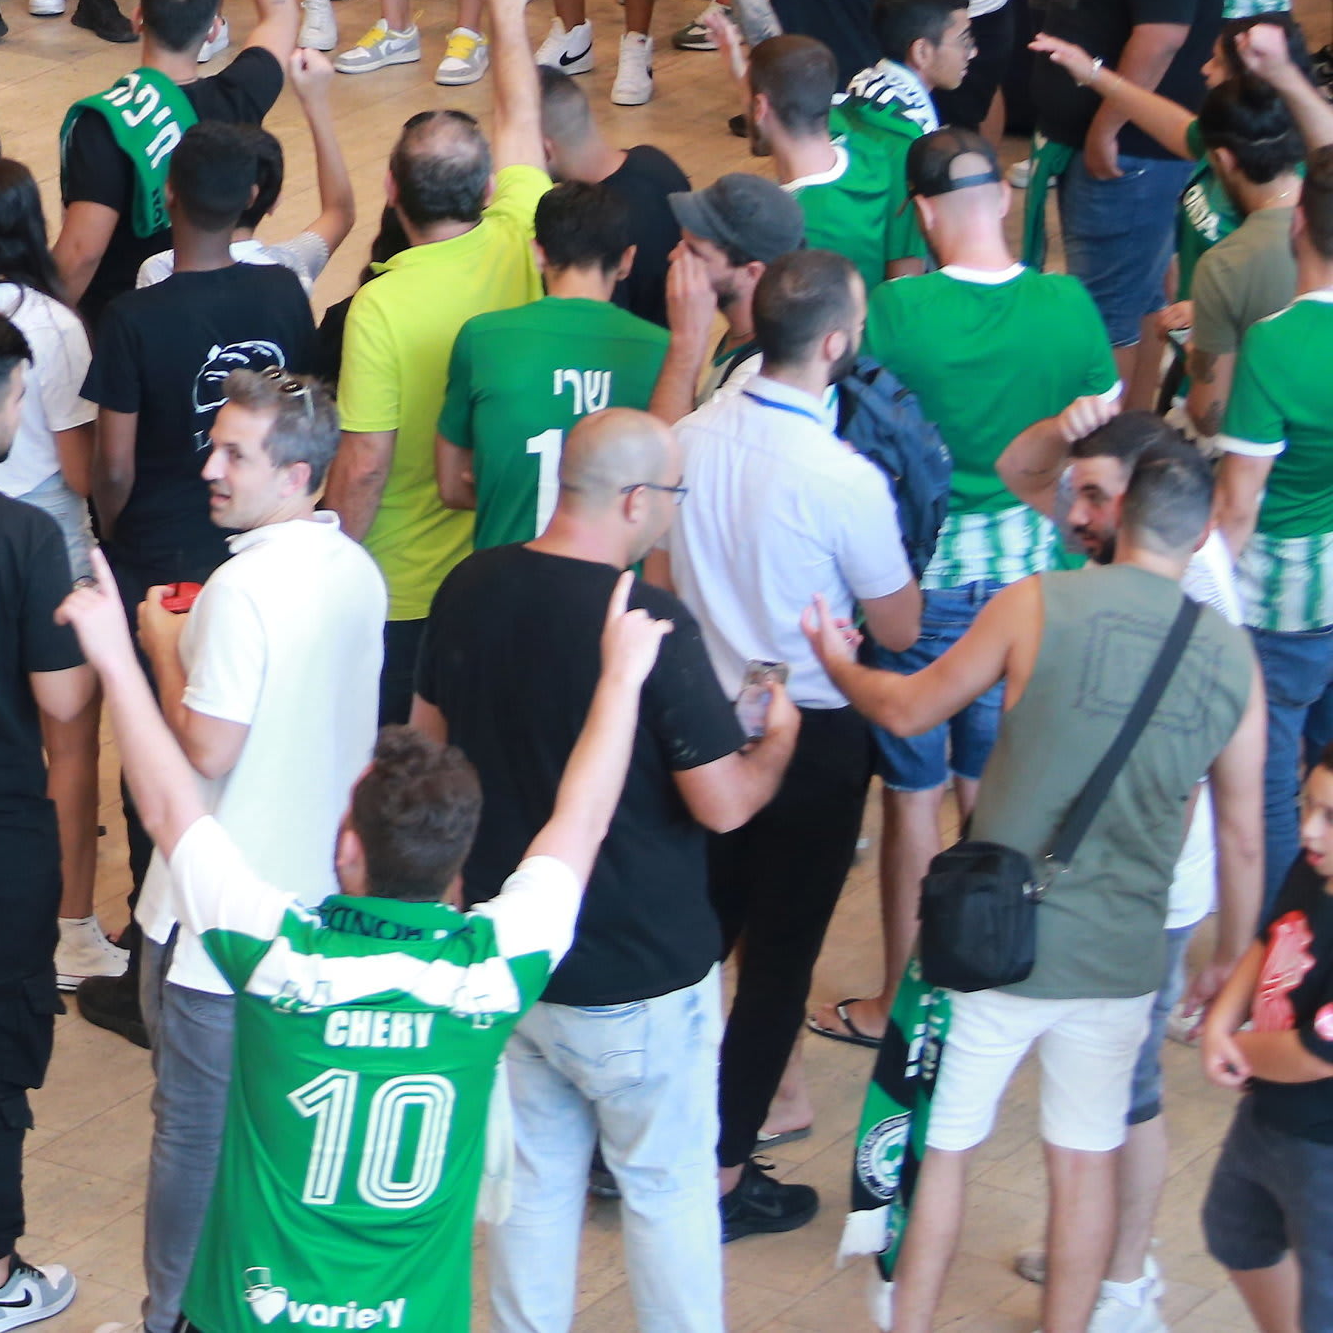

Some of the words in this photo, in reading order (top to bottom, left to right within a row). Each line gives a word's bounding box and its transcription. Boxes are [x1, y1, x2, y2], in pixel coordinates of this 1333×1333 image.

[552, 368, 613, 416] שרי
[323, 906, 423, 942] HOND
[323, 1009, 434, 1050] CHERY
[286, 1067, 457, 1210] 10
